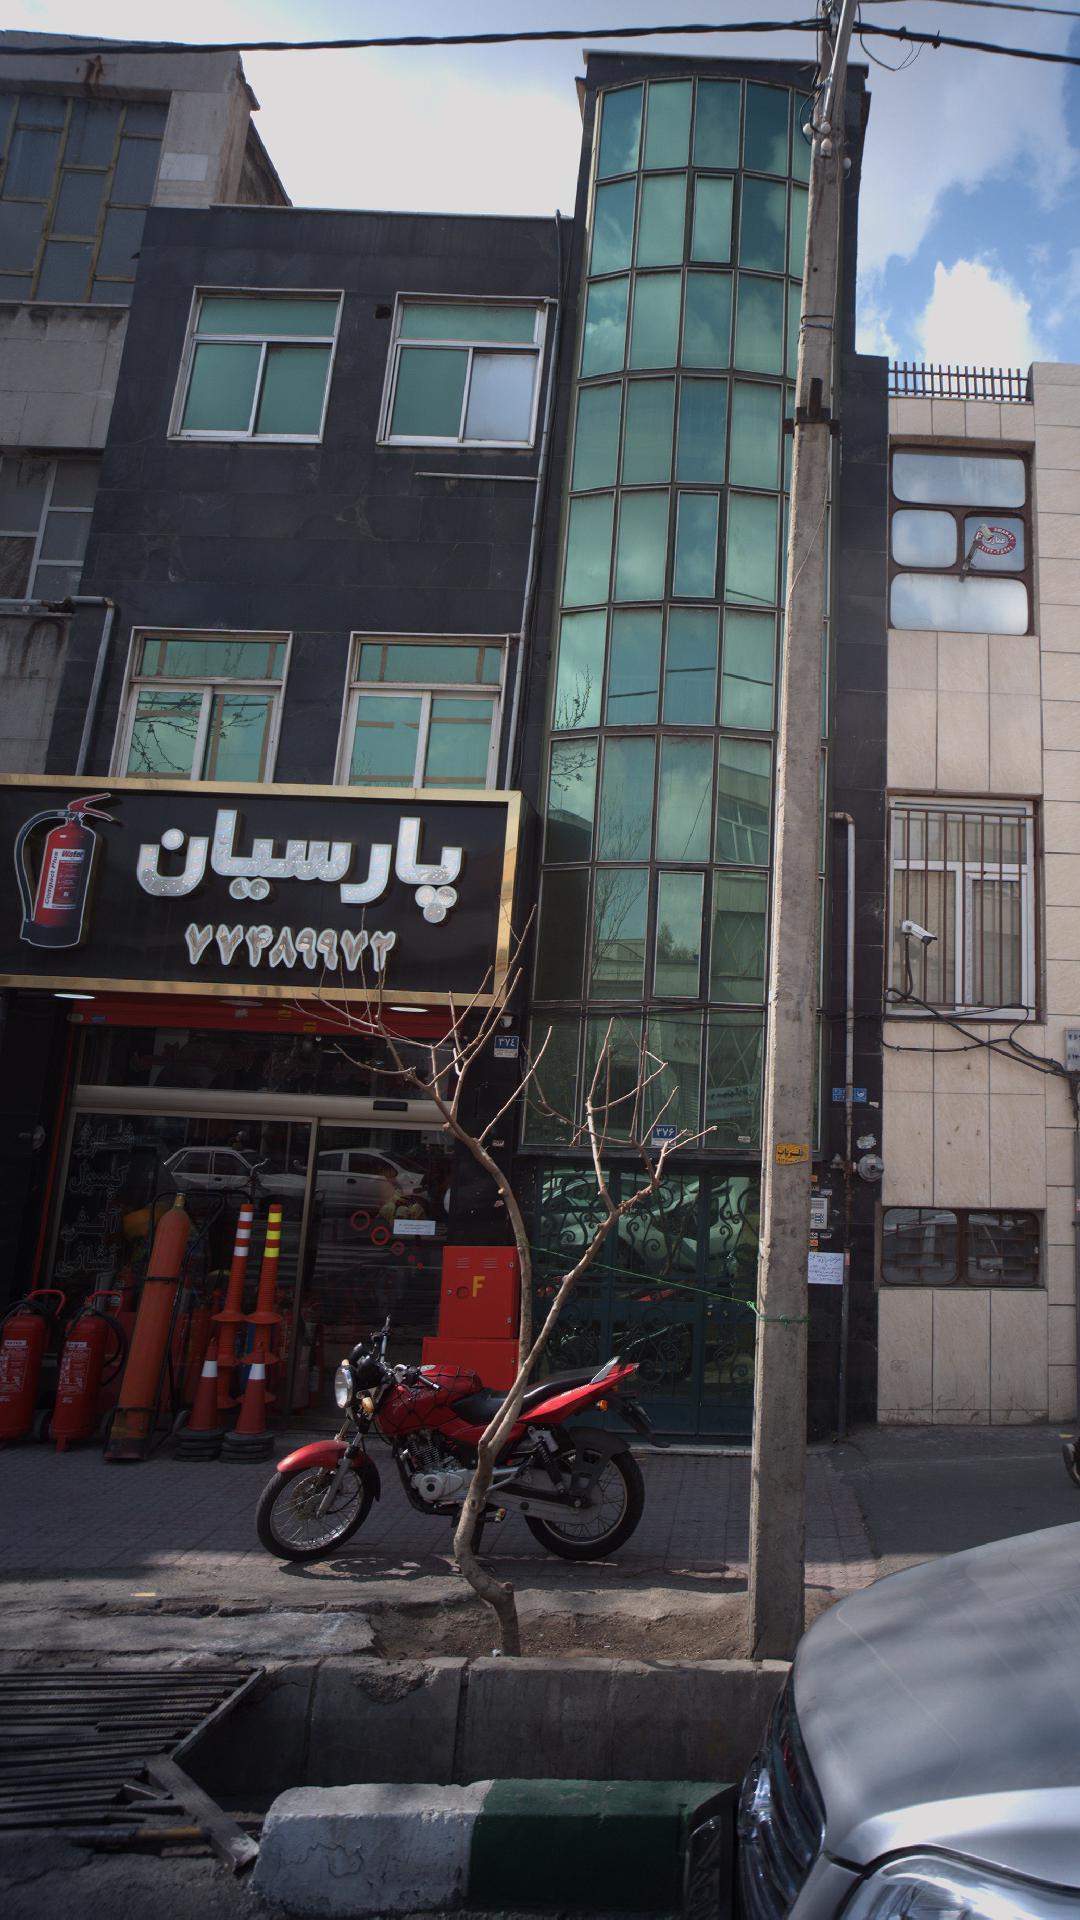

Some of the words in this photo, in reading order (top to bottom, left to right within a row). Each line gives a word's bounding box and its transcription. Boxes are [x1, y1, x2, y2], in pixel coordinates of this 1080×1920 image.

[136, 808, 464, 924] پارسیان
[184, 922, 396, 973] ۷۷۴۸۹۹۷۲
[656, 1127, 674, 1137] ۳۷۶
[472, 1275, 487, 1298] F
